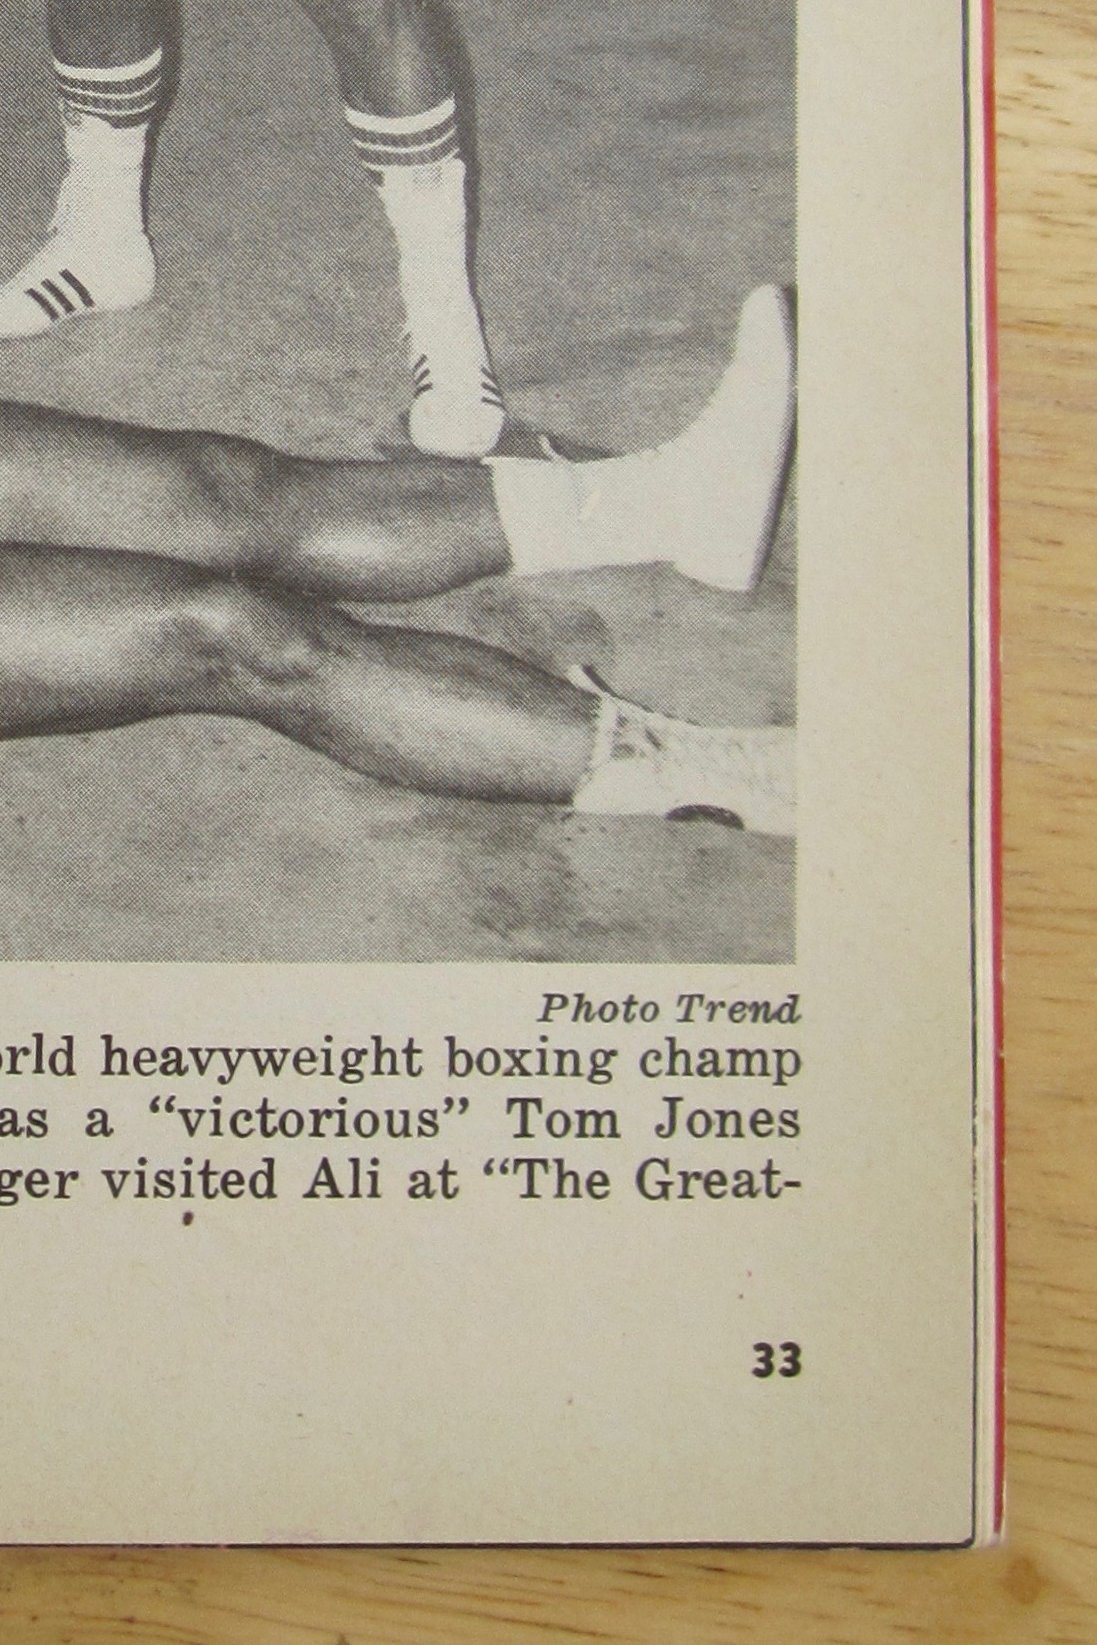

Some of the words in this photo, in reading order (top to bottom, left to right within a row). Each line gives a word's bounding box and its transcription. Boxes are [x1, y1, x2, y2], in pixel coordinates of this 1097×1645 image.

[536, 992, 660, 1024] Photo
[676, 993, 803, 1025] Trend
[100, 1033, 424, 1086] heavyweight
[444, 1034, 619, 1086] boxing
[639, 1036, 803, 1087] champ
[84, 1107, 115, 1138] a
[149, 1094, 470, 1139] “victorious”
[505, 1097, 622, 1139] Tom
[654, 1096, 801, 1139] Jones
[101, 1156, 278, 1200] visited
[302, 1156, 382, 1199] Ali
[407, 1158, 460, 1200] at
[483, 1157, 611, 1201] “The
[635, 1157, 802, 1201] Great-
[752, 1341, 802, 1379] 33
